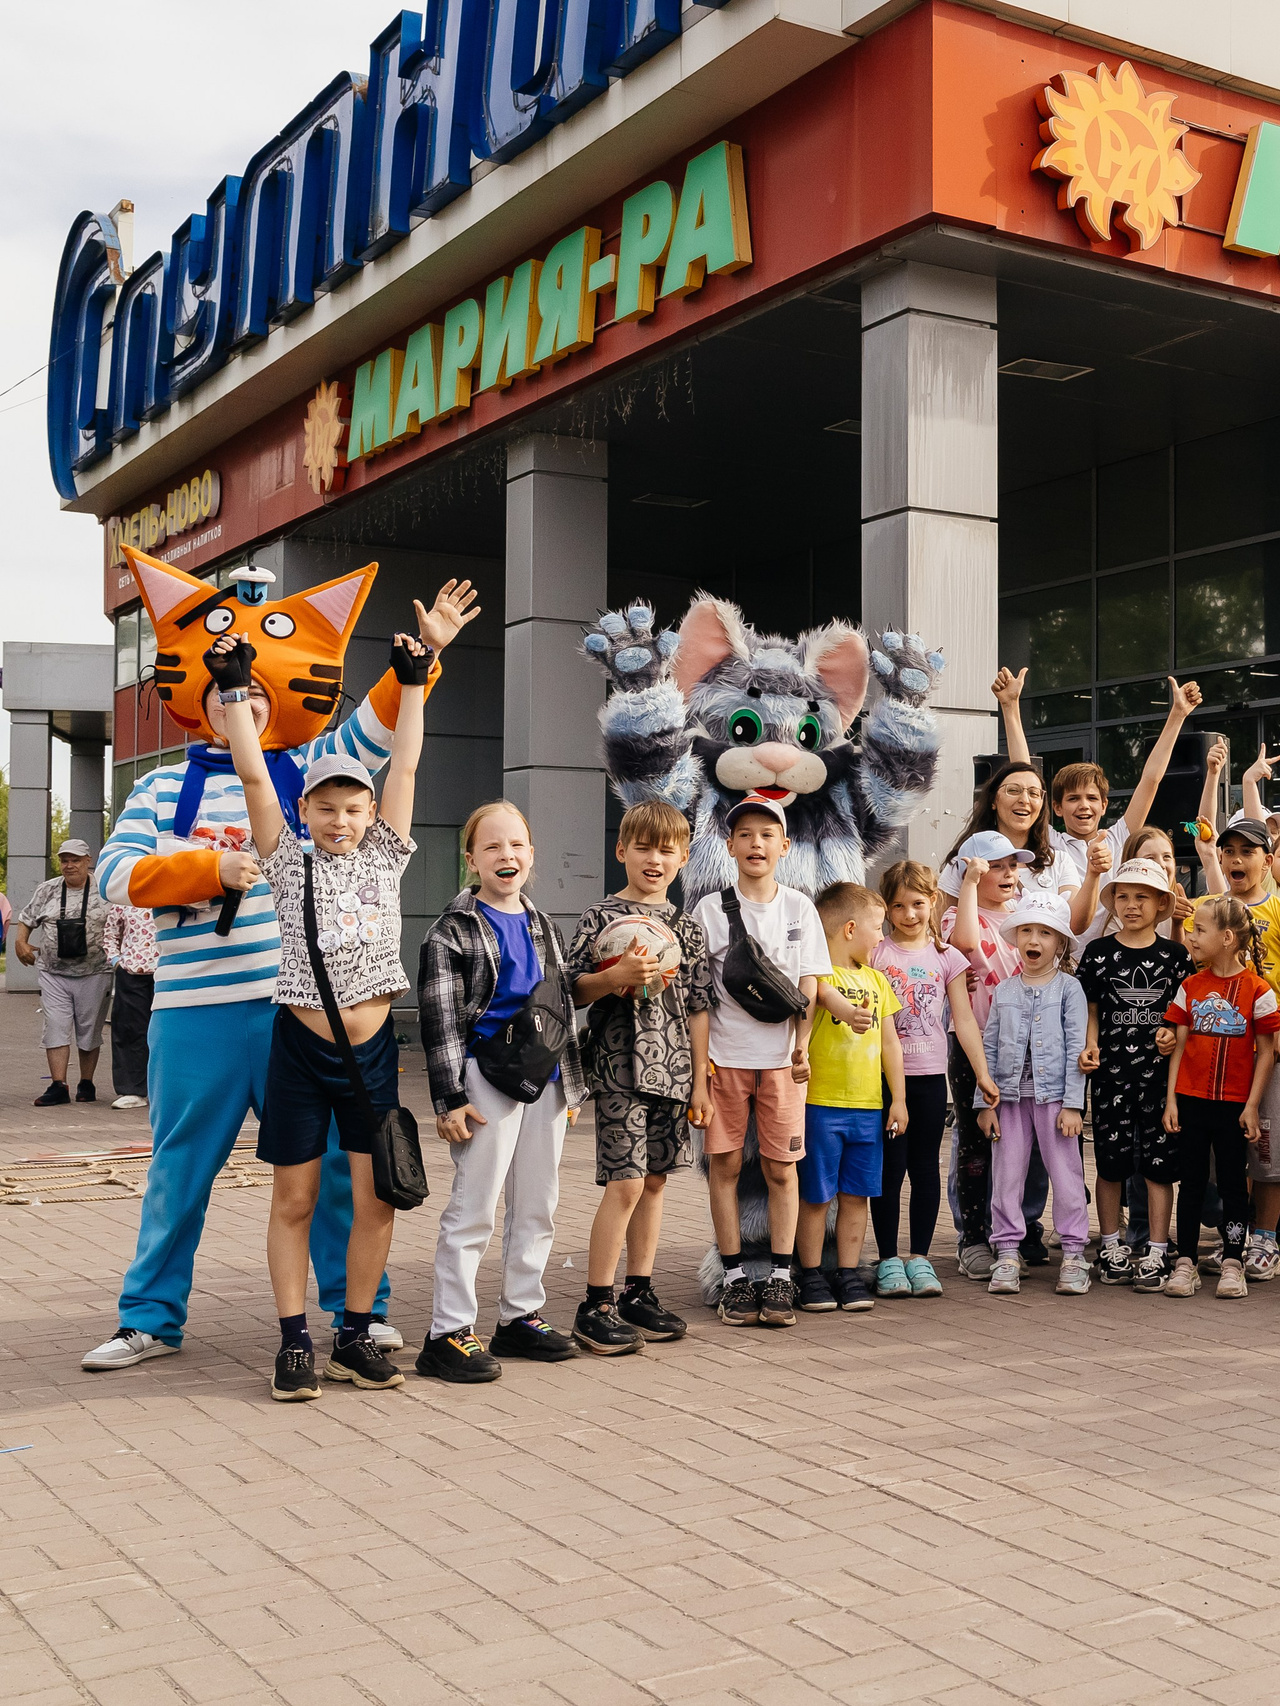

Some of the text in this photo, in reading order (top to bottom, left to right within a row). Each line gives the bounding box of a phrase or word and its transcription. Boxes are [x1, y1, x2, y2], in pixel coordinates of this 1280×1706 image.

[347, 140, 752, 463] МАРИЯ-РА
[192, 524, 222, 551] НАПИТКОВ
[903, 1041, 935, 1056] NYTHING
